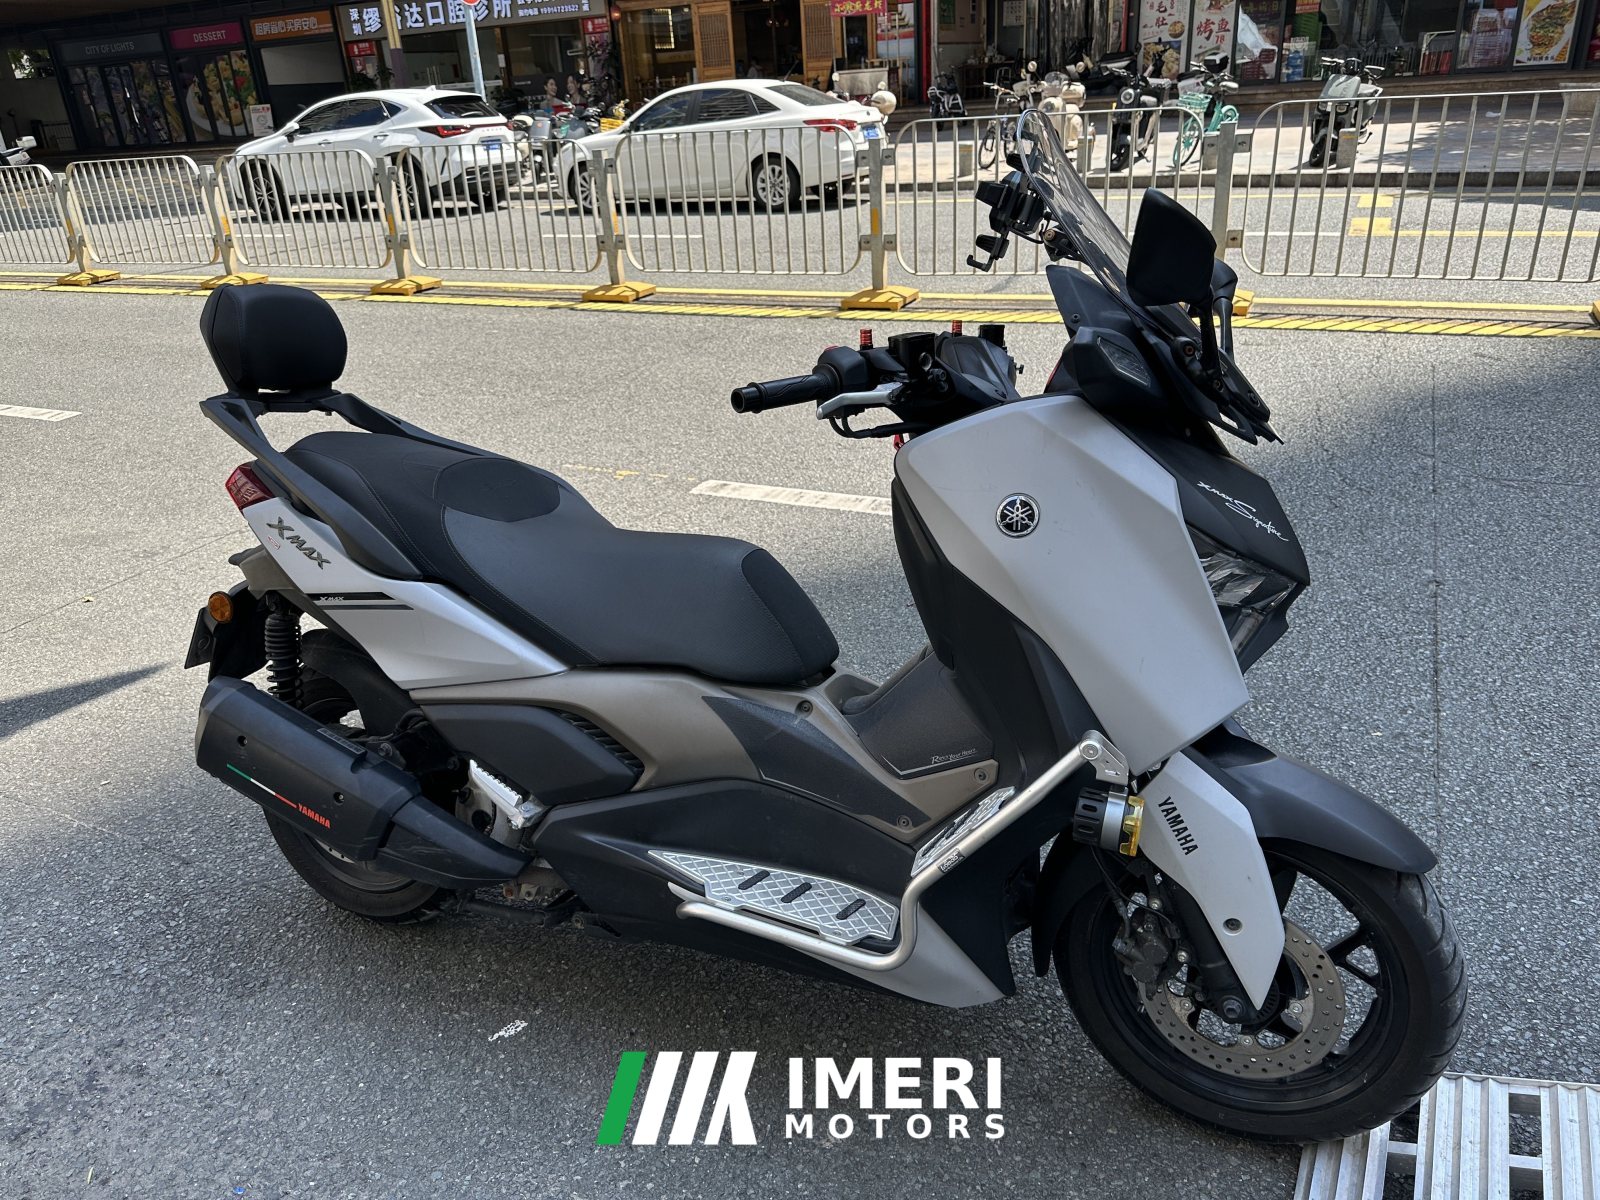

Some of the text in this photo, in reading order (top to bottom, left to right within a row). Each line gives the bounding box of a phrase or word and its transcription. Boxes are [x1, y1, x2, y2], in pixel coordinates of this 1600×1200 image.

[363, 0, 511, 33] 缪达口腔诊所
[85, 41, 135, 55] CITY OF LIGHTS
[193, 30, 226, 42] DESSERT
[298, 802, 331, 829] YAMAHA
[1158, 796, 1199, 856] YAMAHA
